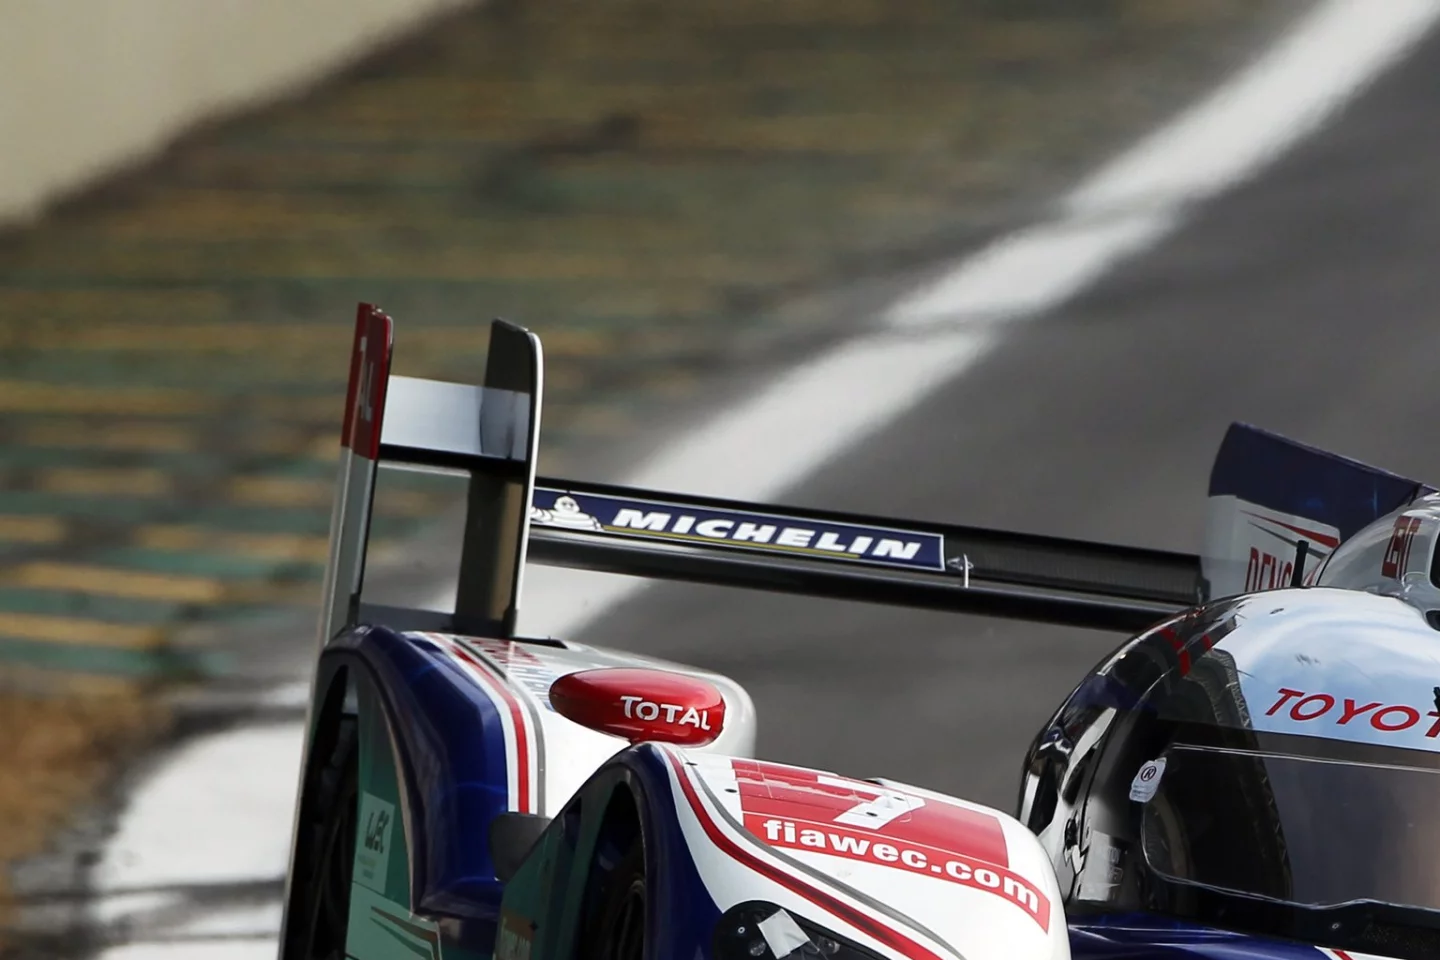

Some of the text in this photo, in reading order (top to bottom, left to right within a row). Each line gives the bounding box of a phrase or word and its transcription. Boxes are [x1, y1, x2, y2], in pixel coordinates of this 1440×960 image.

[612, 509, 921, 560] MICHELIN
[620, 695, 711, 731] TOTAL
[763, 819, 1039, 913] fiawec.com
